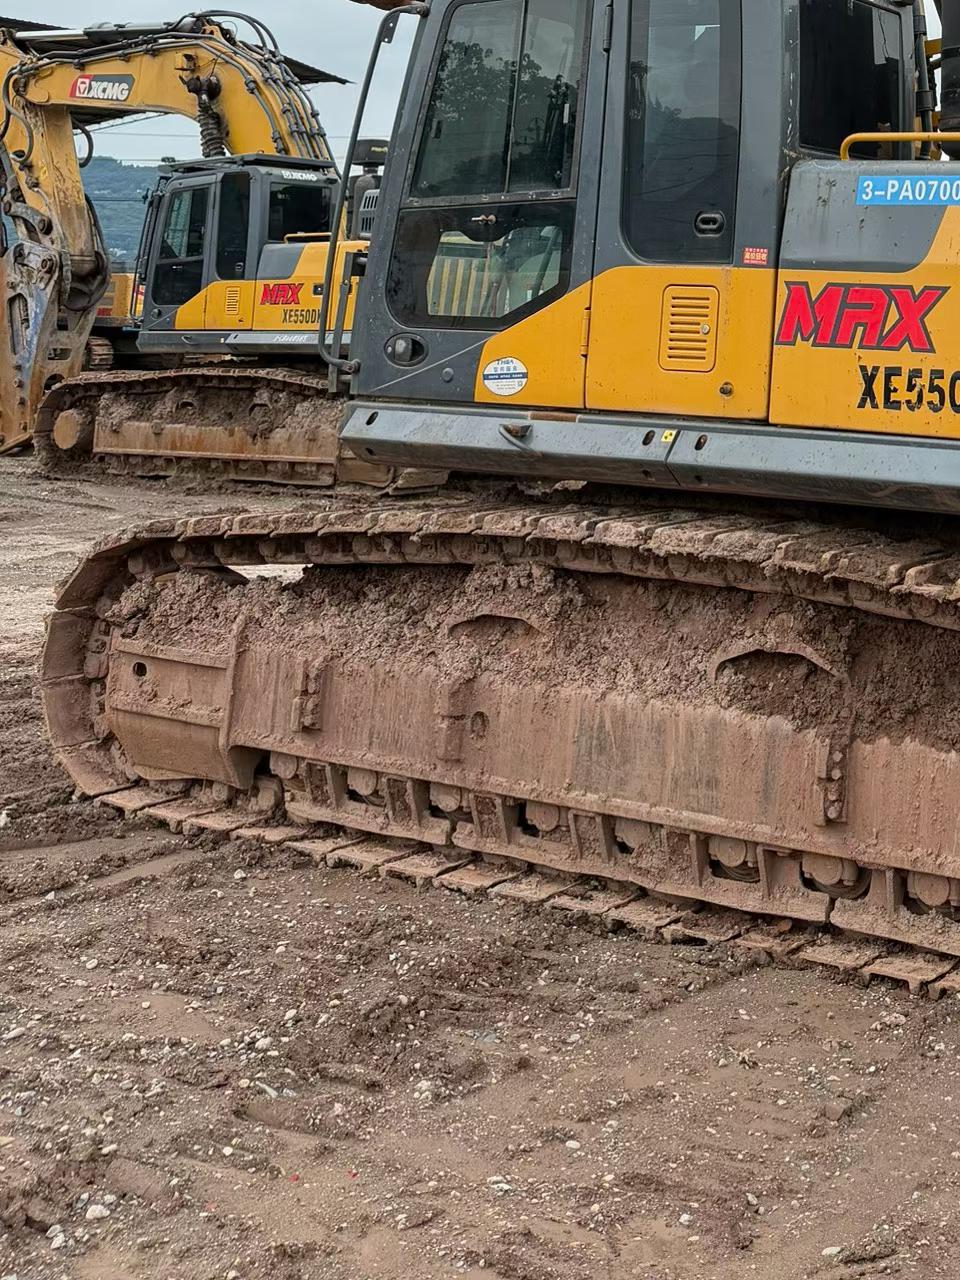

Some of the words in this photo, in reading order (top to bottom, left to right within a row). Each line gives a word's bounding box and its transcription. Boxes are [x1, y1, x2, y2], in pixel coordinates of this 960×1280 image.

[88, 81, 130, 100] XCMG
[260, 283, 305, 305] MAX
[775, 280, 951, 354] MAX
